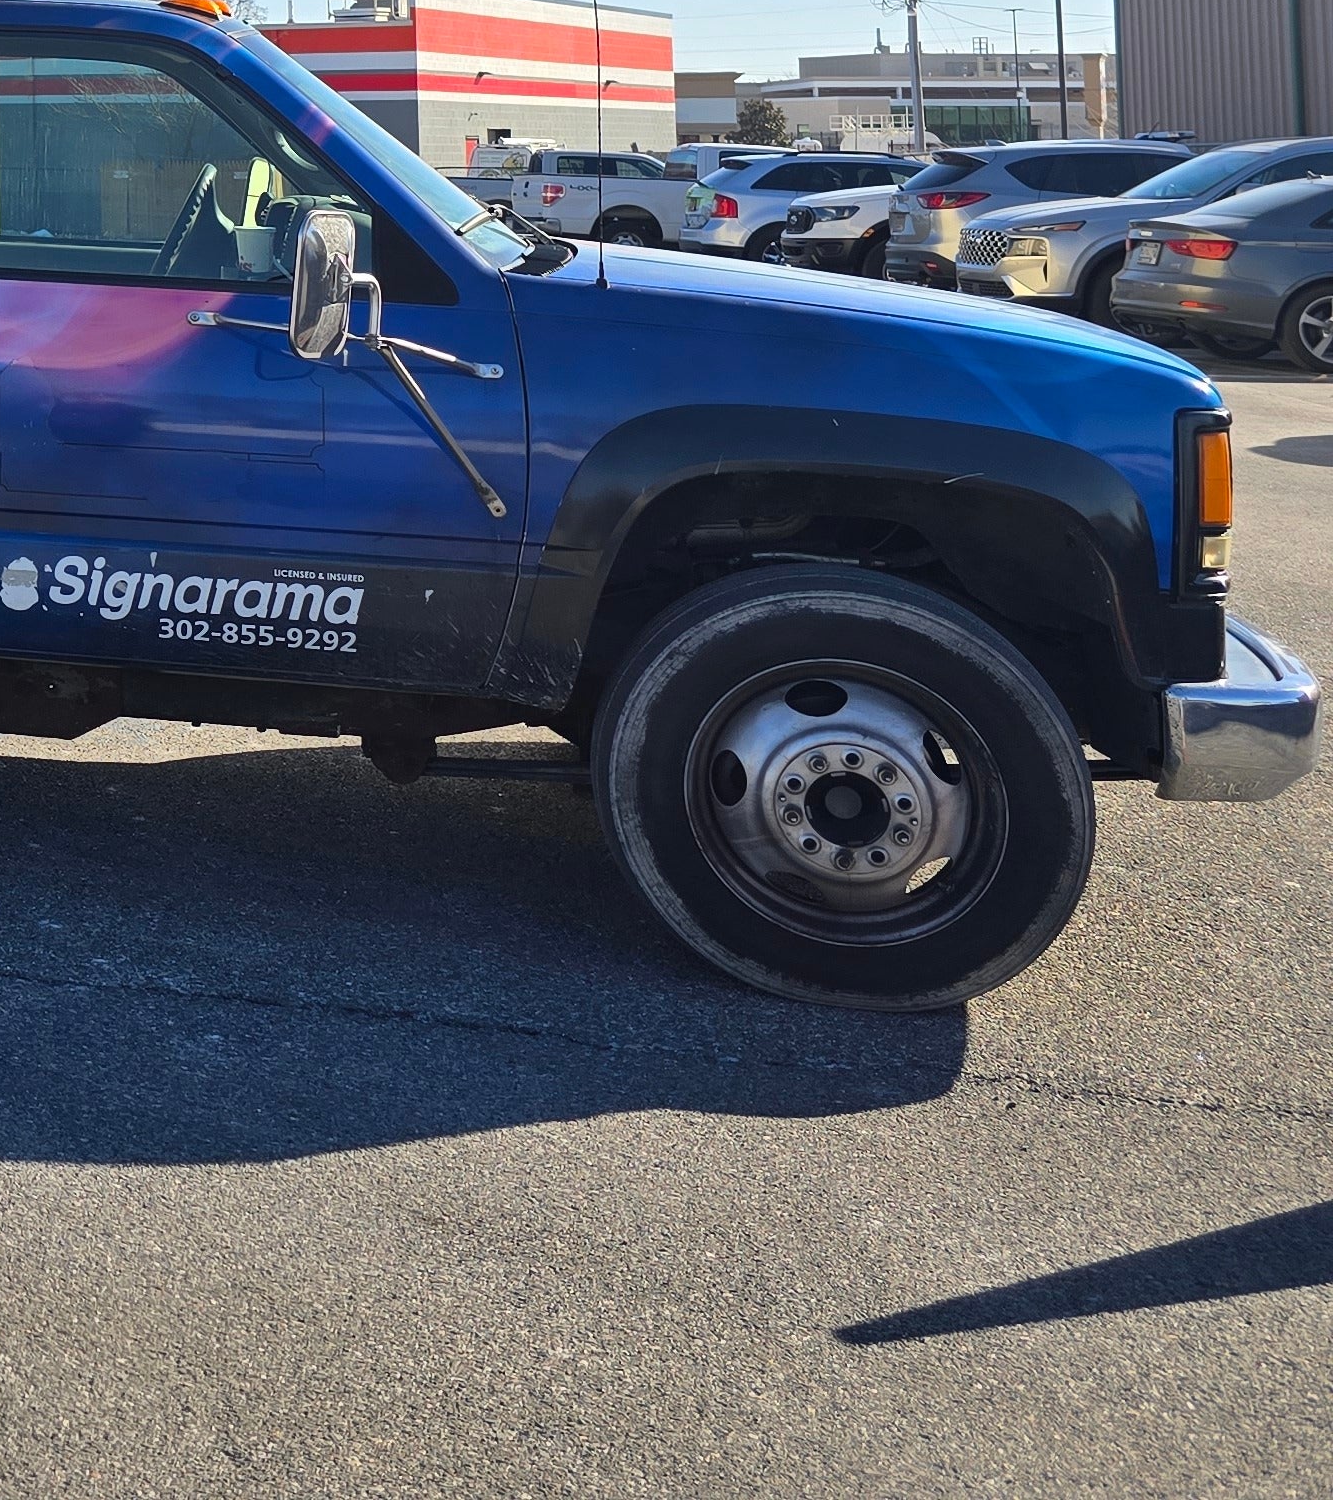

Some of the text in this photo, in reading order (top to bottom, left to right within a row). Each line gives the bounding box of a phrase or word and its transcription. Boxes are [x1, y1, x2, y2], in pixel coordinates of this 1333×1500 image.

[48, 555, 365, 625] Signarama
[273, 568, 365, 583] LICENSED & INSURED
[158, 618, 358, 653] 302-855-9292
